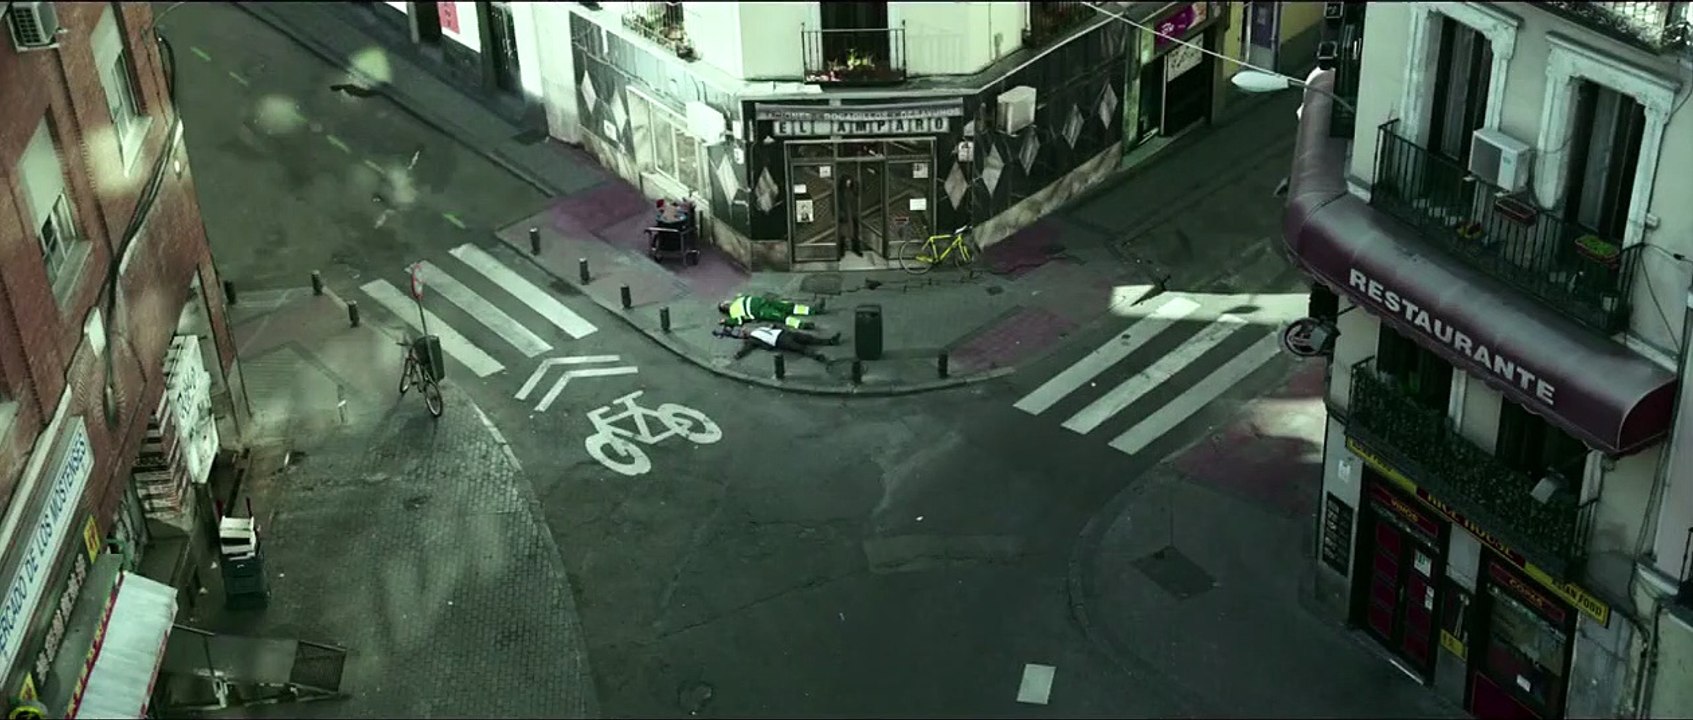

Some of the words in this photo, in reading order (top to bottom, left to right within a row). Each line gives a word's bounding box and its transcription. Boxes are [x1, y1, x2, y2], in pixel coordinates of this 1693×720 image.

[779, 122, 806, 133] EL
[837, 119, 943, 133] AMPARO
[1350, 268, 1555, 405] RESTAURANTE
[25, 548, 39, 583] DE
[37, 514, 52, 557] LOS
[50, 431, 86, 523] MOSTENSES
